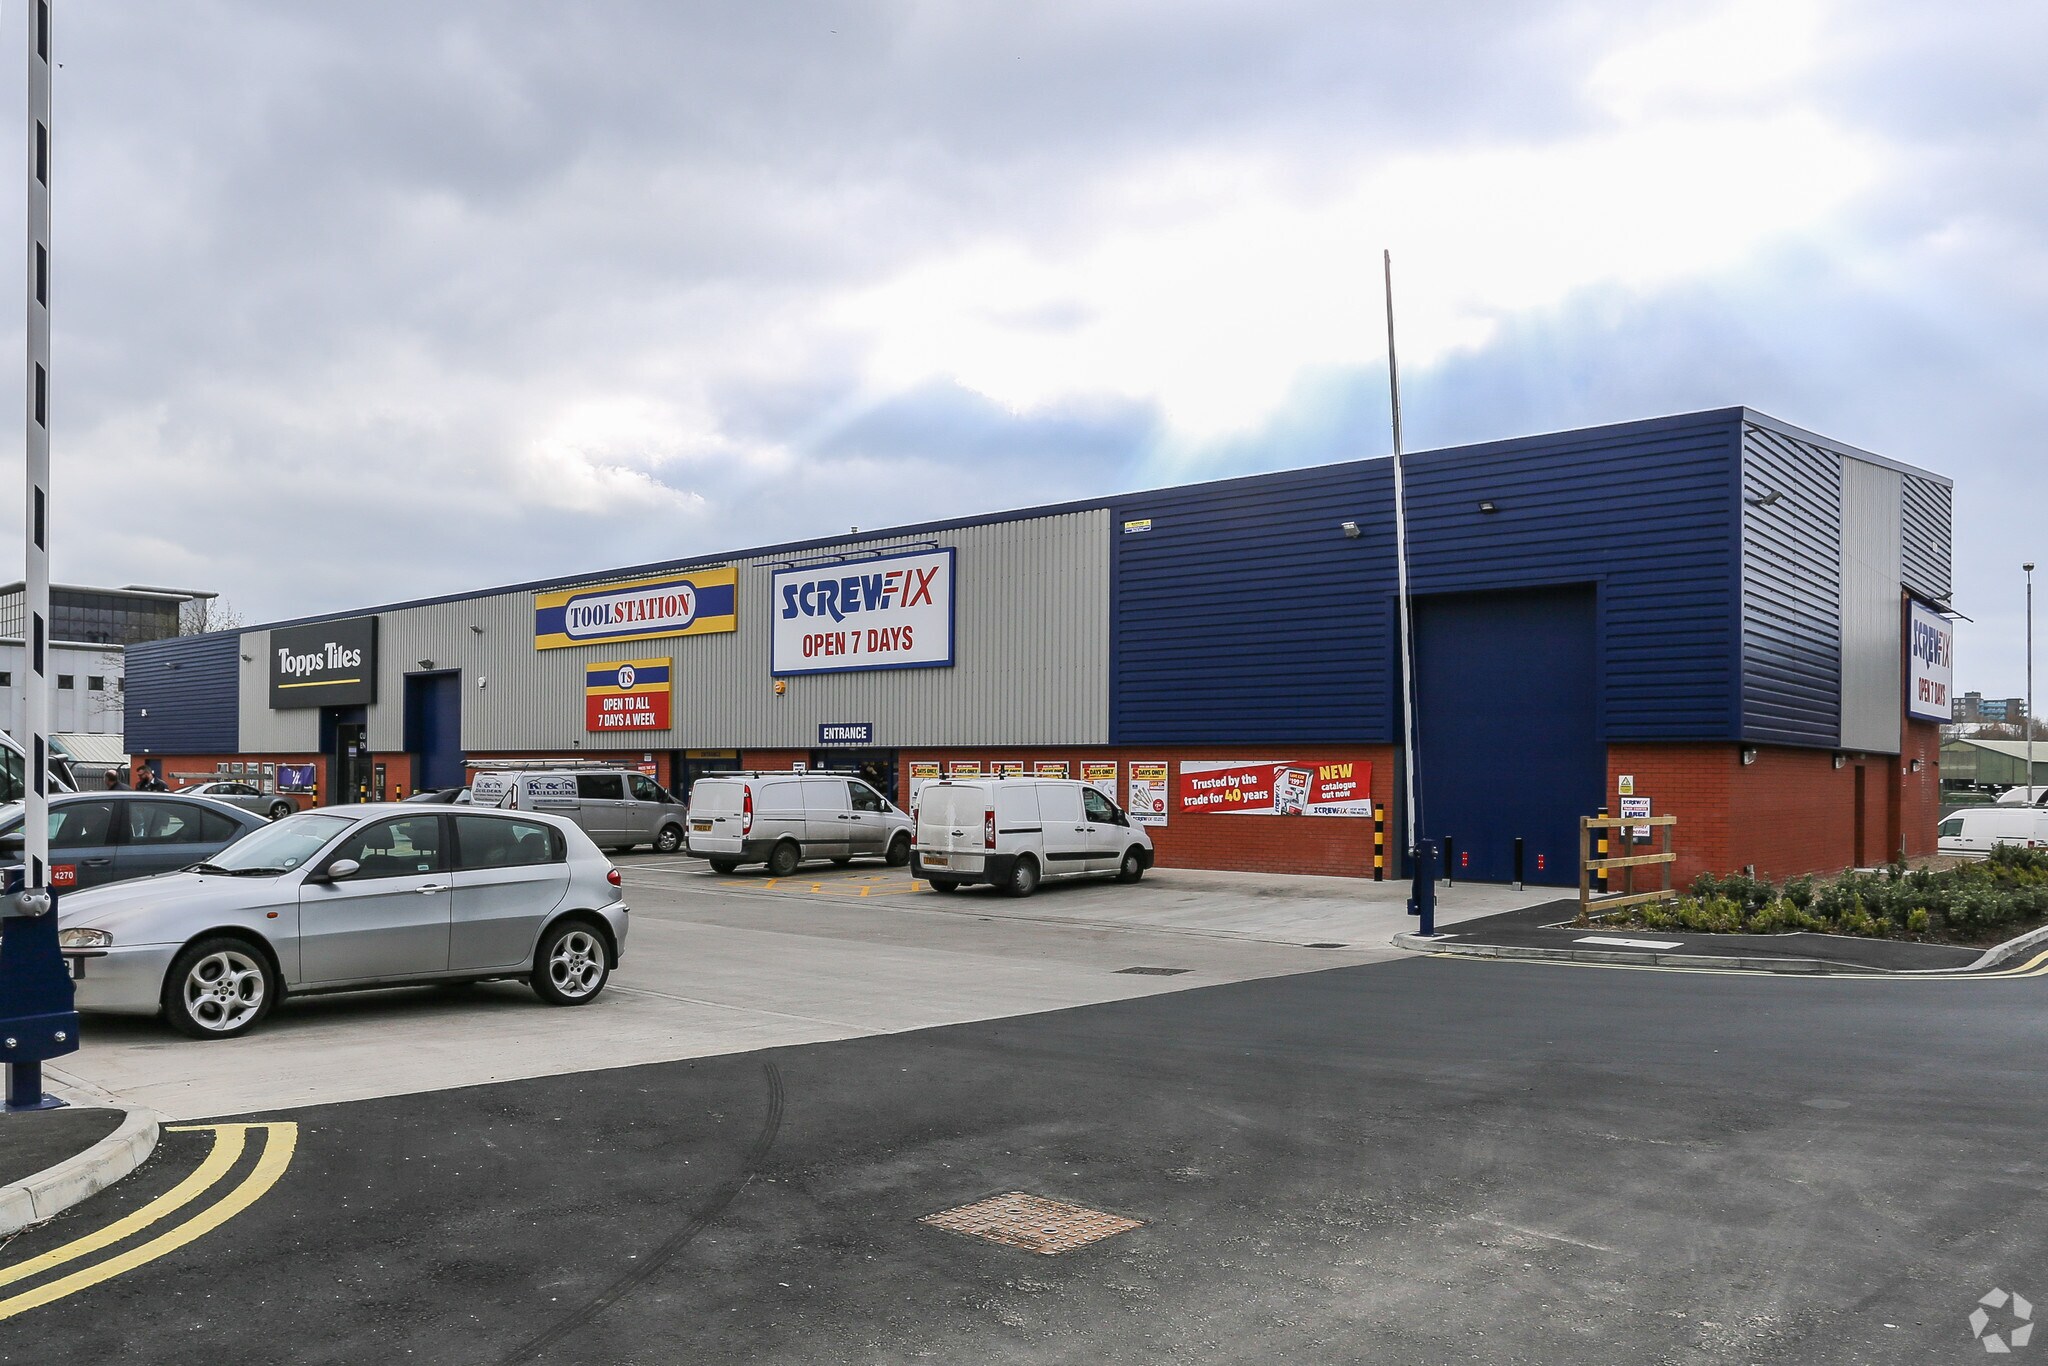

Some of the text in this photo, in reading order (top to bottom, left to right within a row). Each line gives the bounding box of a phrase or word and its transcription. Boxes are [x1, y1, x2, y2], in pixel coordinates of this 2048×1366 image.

[782, 566, 939, 623] SCREWFIX
[570, 593, 690, 628] TOOLSTATION
[803, 625, 913, 658] OPEN 7 DAYS
[1913, 619, 1950, 669] SCREWFIX
[278, 642, 361, 677] Topps Tiles
[620, 671, 633, 684] TS
[1918, 677, 1930, 702] OPEN
[1935, 682, 1946, 707] DAYS
[603, 696, 650, 711] OPEN TO ALL
[598, 712, 655, 727] 7 DAYS A WEEK
[823, 726, 867, 740] ENTRANCE
[1084, 769, 1089, 779] 5
[1132, 769, 1139, 779] 5
[1319, 763, 1353, 781] NEW
[529, 781, 575, 790] K & N
[1192, 773, 1257, 790] Trusted by the
[1321, 781, 1357, 791] catalogue
[1184, 788, 1269, 806] trade for 40 years
[1321, 790, 1350, 799] out now
[1313, 807, 1348, 815] SCREWFIX
[54, 871, 74, 880] 4270
